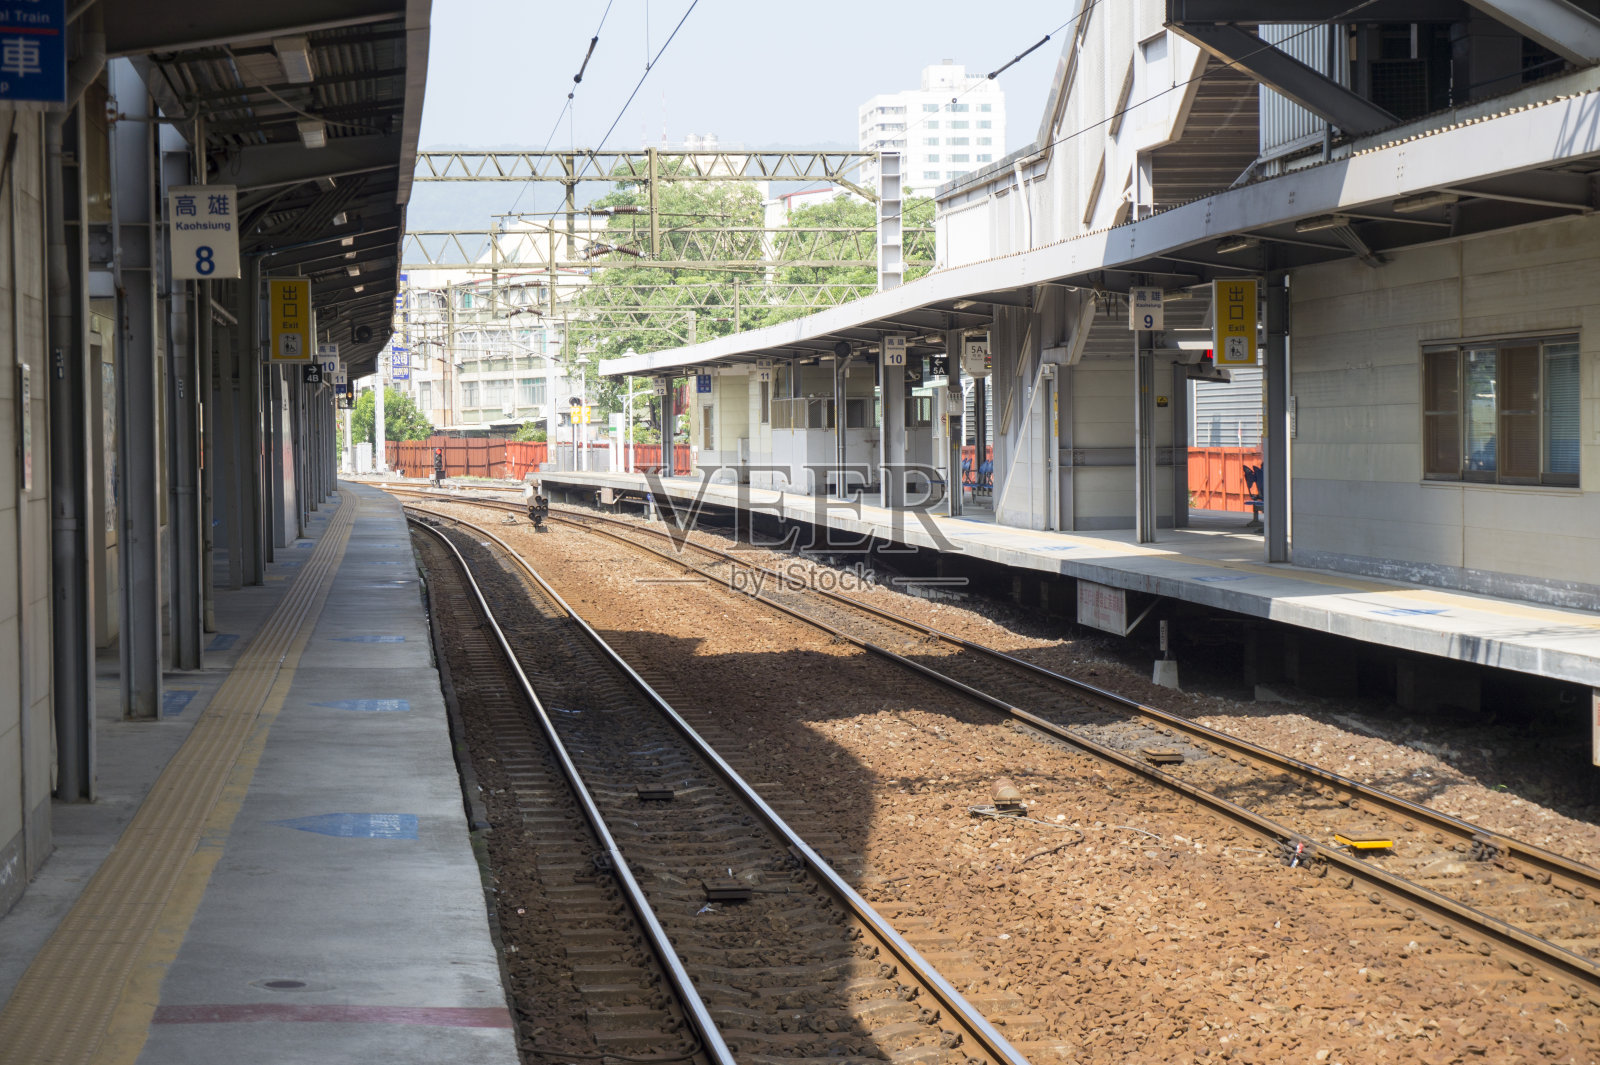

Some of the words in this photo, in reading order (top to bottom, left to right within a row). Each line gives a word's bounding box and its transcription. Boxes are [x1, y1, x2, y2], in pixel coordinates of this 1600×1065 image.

[15, 11, 51, 24] Train
[1, 38, 42, 78] 車
[175, 194, 230, 216] 高雄
[176, 221, 231, 231] Kaohsiung
[195, 245, 215, 276] 8
[283, 285, 297, 317] 出口
[1229, 286, 1244, 320] 出口
[283, 321, 298, 329] Exit
[1143, 314, 1153, 329] 9
[1228, 324, 1245, 332] Exit
[971, 345, 983, 354] 5A
[889, 354, 903, 364] 10
[322, 361, 335, 372] 10
[933, 367, 945, 375] 5A
[307, 374, 319, 382] 4B
[336, 375, 344, 383] 11
[760, 372, 770, 380] 11
